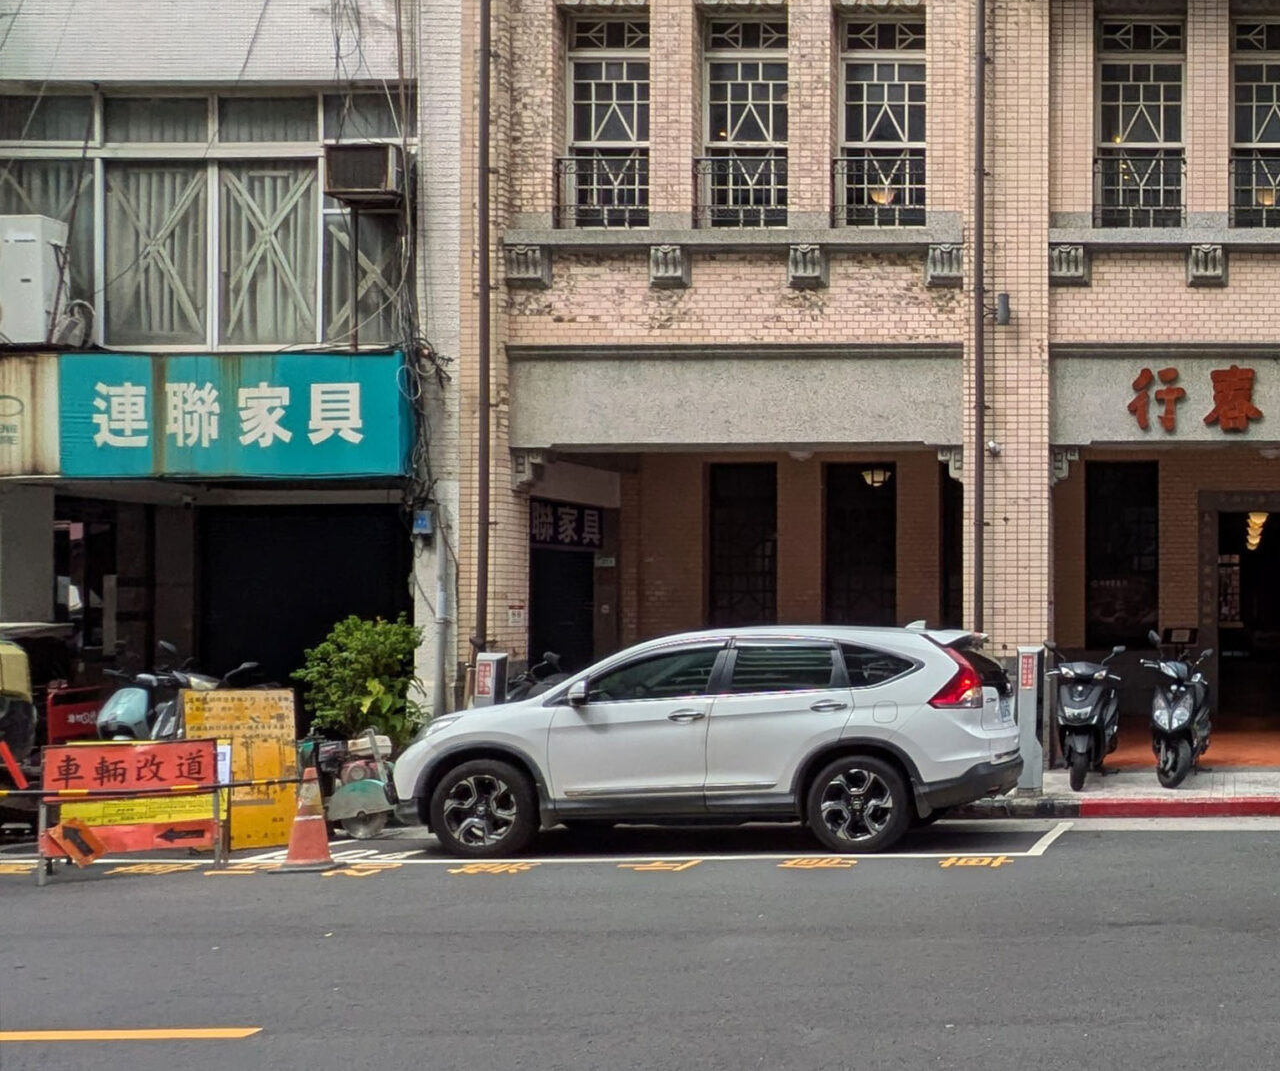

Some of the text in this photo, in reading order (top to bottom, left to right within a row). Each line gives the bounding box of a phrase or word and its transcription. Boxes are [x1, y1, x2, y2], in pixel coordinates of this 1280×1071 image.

[92, 381, 363, 448] 連聯家具
[51, 749, 207, 788] 車輛改道
